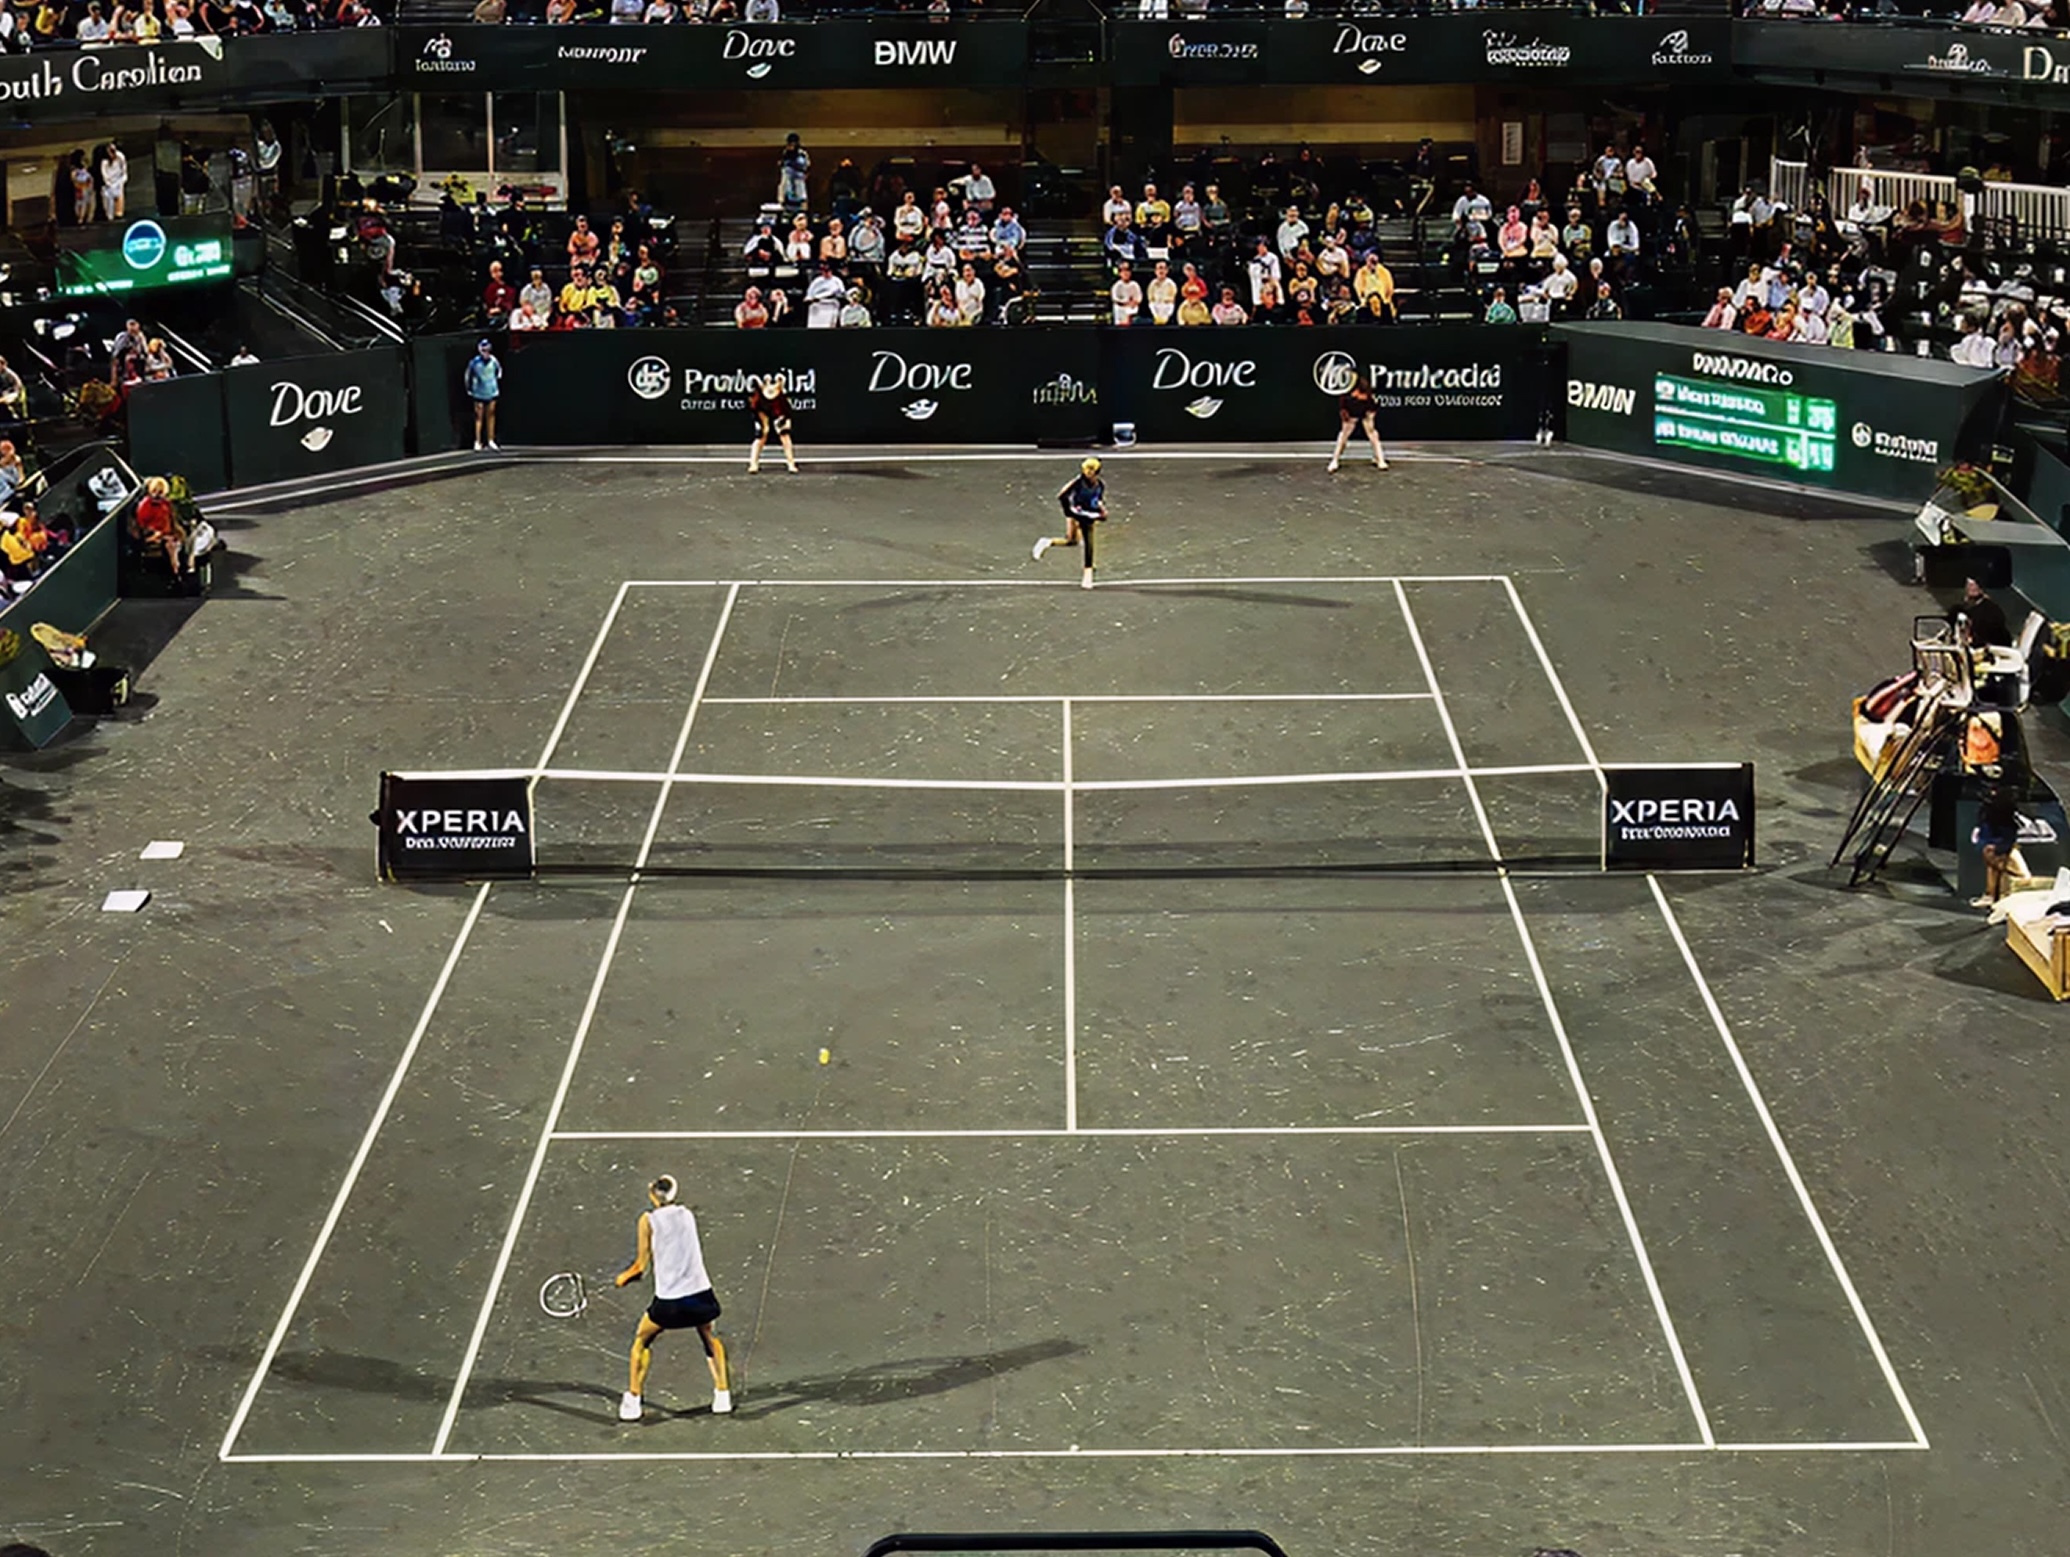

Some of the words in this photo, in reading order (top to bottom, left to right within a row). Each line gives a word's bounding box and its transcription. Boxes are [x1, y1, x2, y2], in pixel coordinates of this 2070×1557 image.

[874, 40, 957, 66] BMW
[868, 350, 973, 392] Dove
[1152, 347, 1257, 389] Dove
[270, 381, 363, 427] Dove
[396, 809, 526, 834] XPERIA
[1612, 799, 1740, 824] XPERIA
